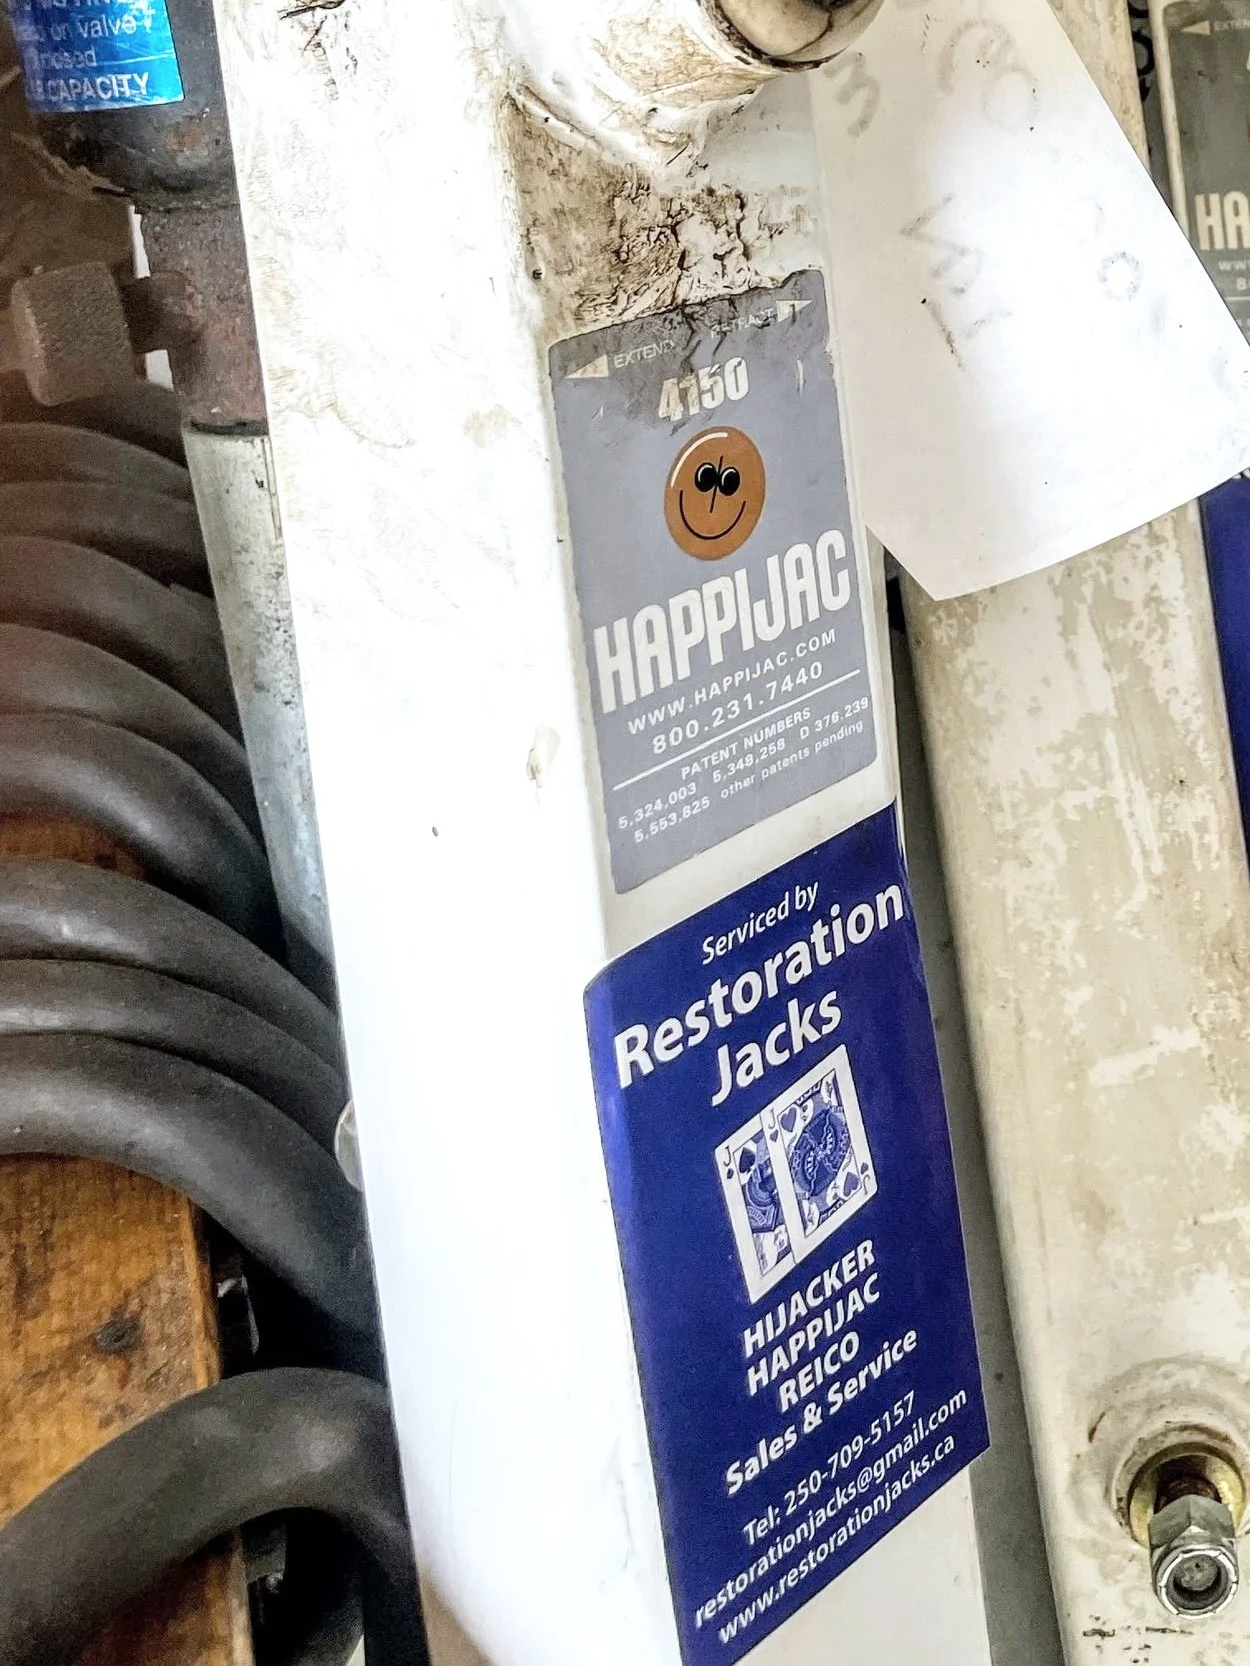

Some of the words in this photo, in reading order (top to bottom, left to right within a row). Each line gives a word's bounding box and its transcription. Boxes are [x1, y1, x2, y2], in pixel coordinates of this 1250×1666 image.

[47, 72, 149, 102] CAPACITY
[658, 357, 749, 422] 4150
[594, 529, 851, 715] HAPPIJAC
[627, 628, 836, 735] WWW.HAPPIJAC.COM
[653, 661, 823, 754] 800.231.7440
[800, 725, 810, 740] D
[681, 741, 738, 781] PATENT
[743, 707, 811, 751] NUMBERS
[720, 772, 756, 799] other
[761, 748, 810, 782] patents
[814, 720, 864, 755] pending
[702, 891, 789, 965] Serviced
[795, 882, 819, 912] by
[614, 884, 904, 1090] Restoration
[711, 990, 842, 1107] Jacks
[743, 1239, 876, 1358] HIJACKER
[747, 1272, 880, 1396] HAPPIJAC
[725, 1425, 797, 1496] Sales
[803, 1401, 823, 1434] &
[827, 1330, 917, 1415] Service
[778, 1331, 860, 1413] REICO
[695, 1389, 967, 1628] restorationjacks@gmail.com
[742, 1505, 781, 1546] Tel:
[784, 1389, 915, 1517] 250-709-5157
[719, 1435, 955, 1644] www.restorationjacks.ca
